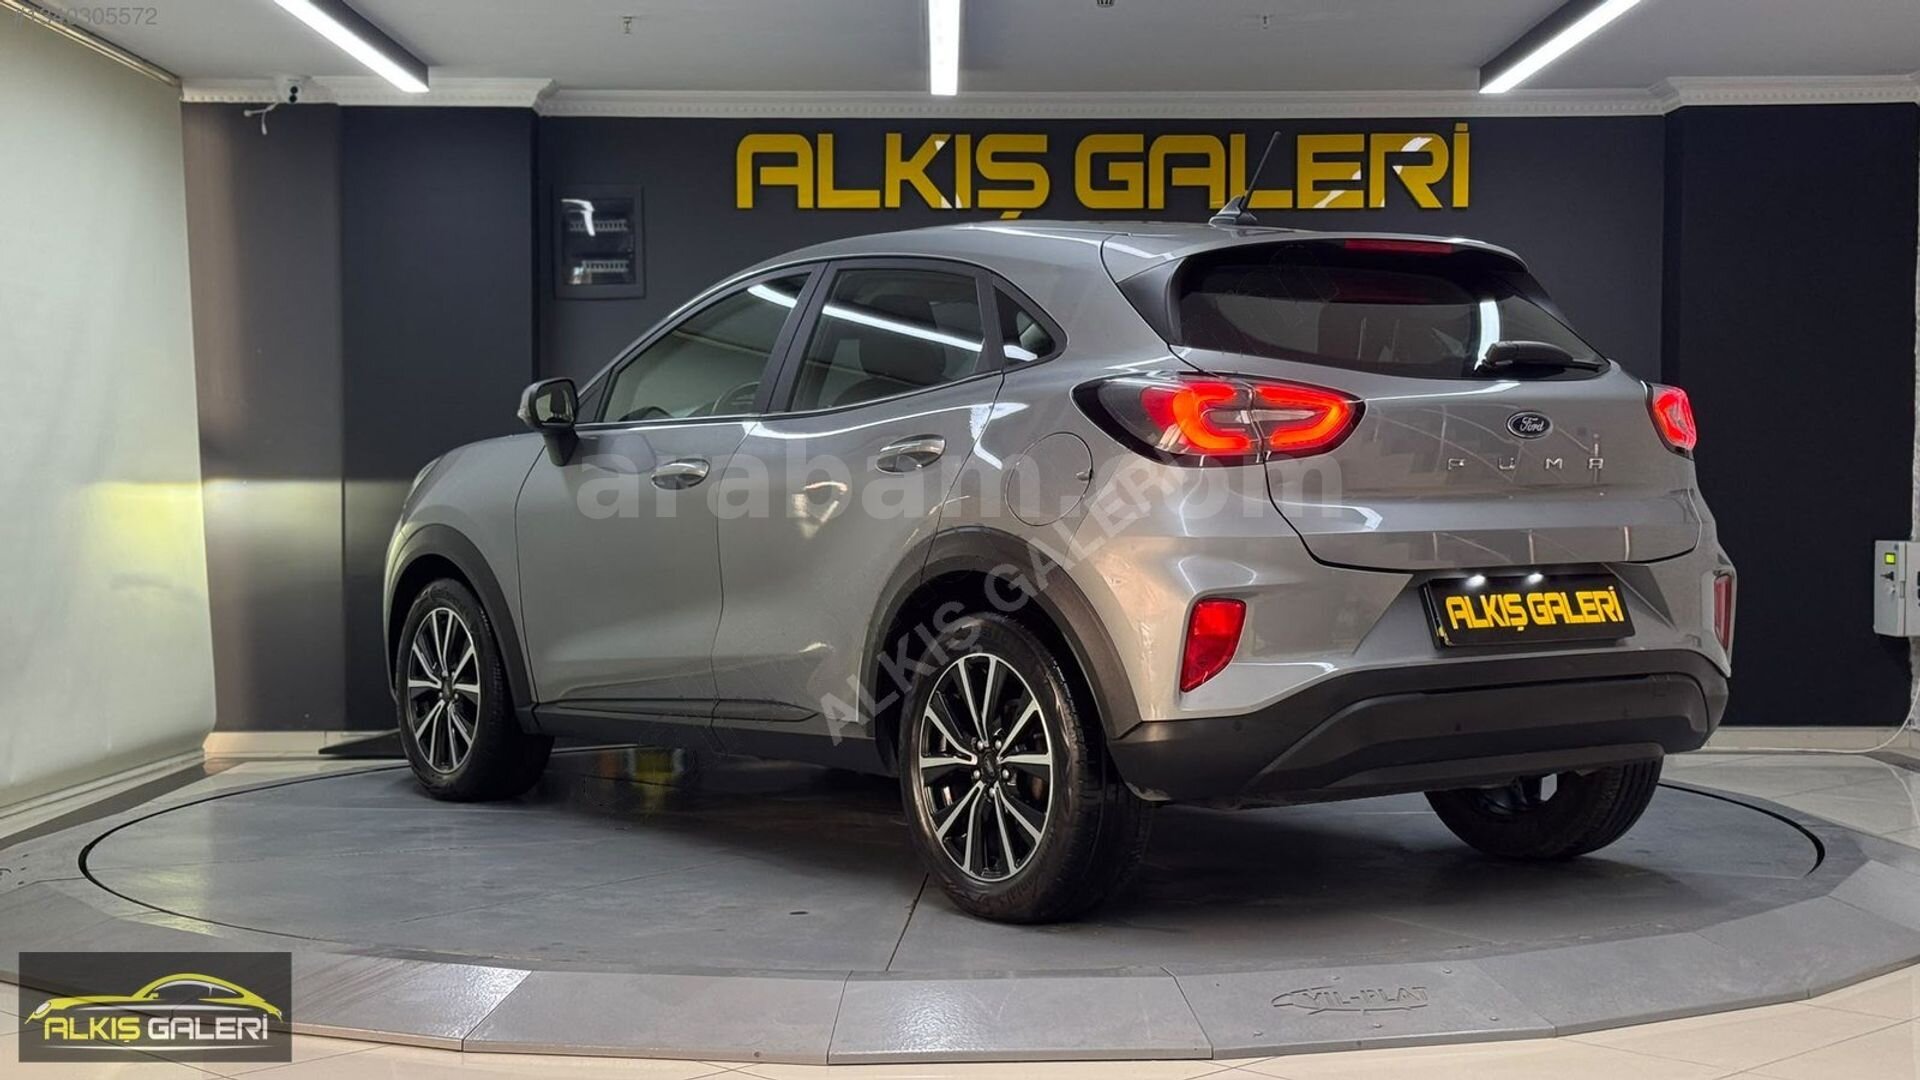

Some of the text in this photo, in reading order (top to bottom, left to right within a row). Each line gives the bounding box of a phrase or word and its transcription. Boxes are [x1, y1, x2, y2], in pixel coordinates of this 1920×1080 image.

[736, 122, 1469, 220] ALKIŞ GALERİ
[1448, 457, 1604, 470] PUMA
[1445, 585, 1625, 632] ALKIŞ GALERİ
